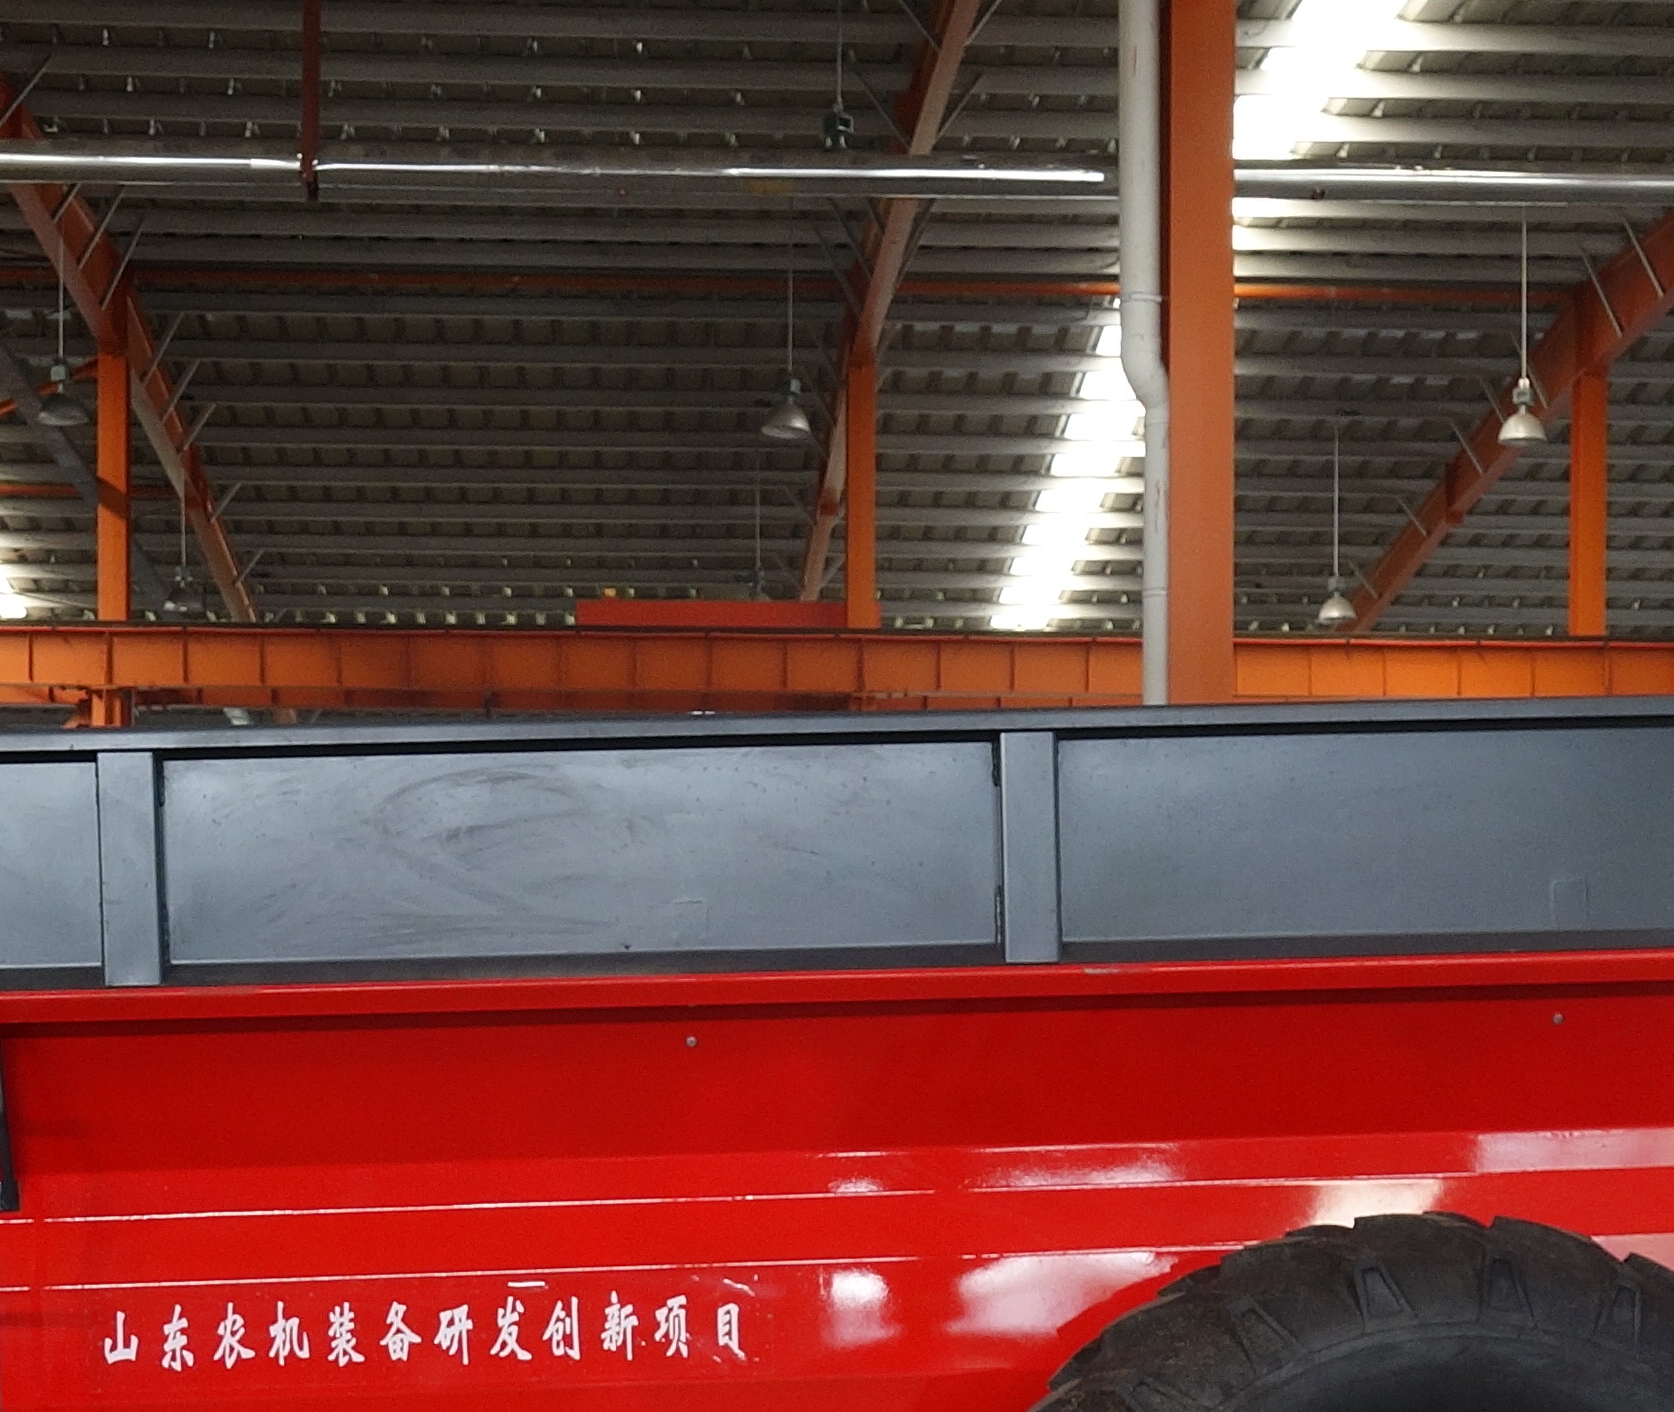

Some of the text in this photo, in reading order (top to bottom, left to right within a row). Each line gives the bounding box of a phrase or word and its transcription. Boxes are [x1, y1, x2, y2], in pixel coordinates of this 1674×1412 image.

[103, 1291, 747, 1372] 山东农机装备研发创新项目
